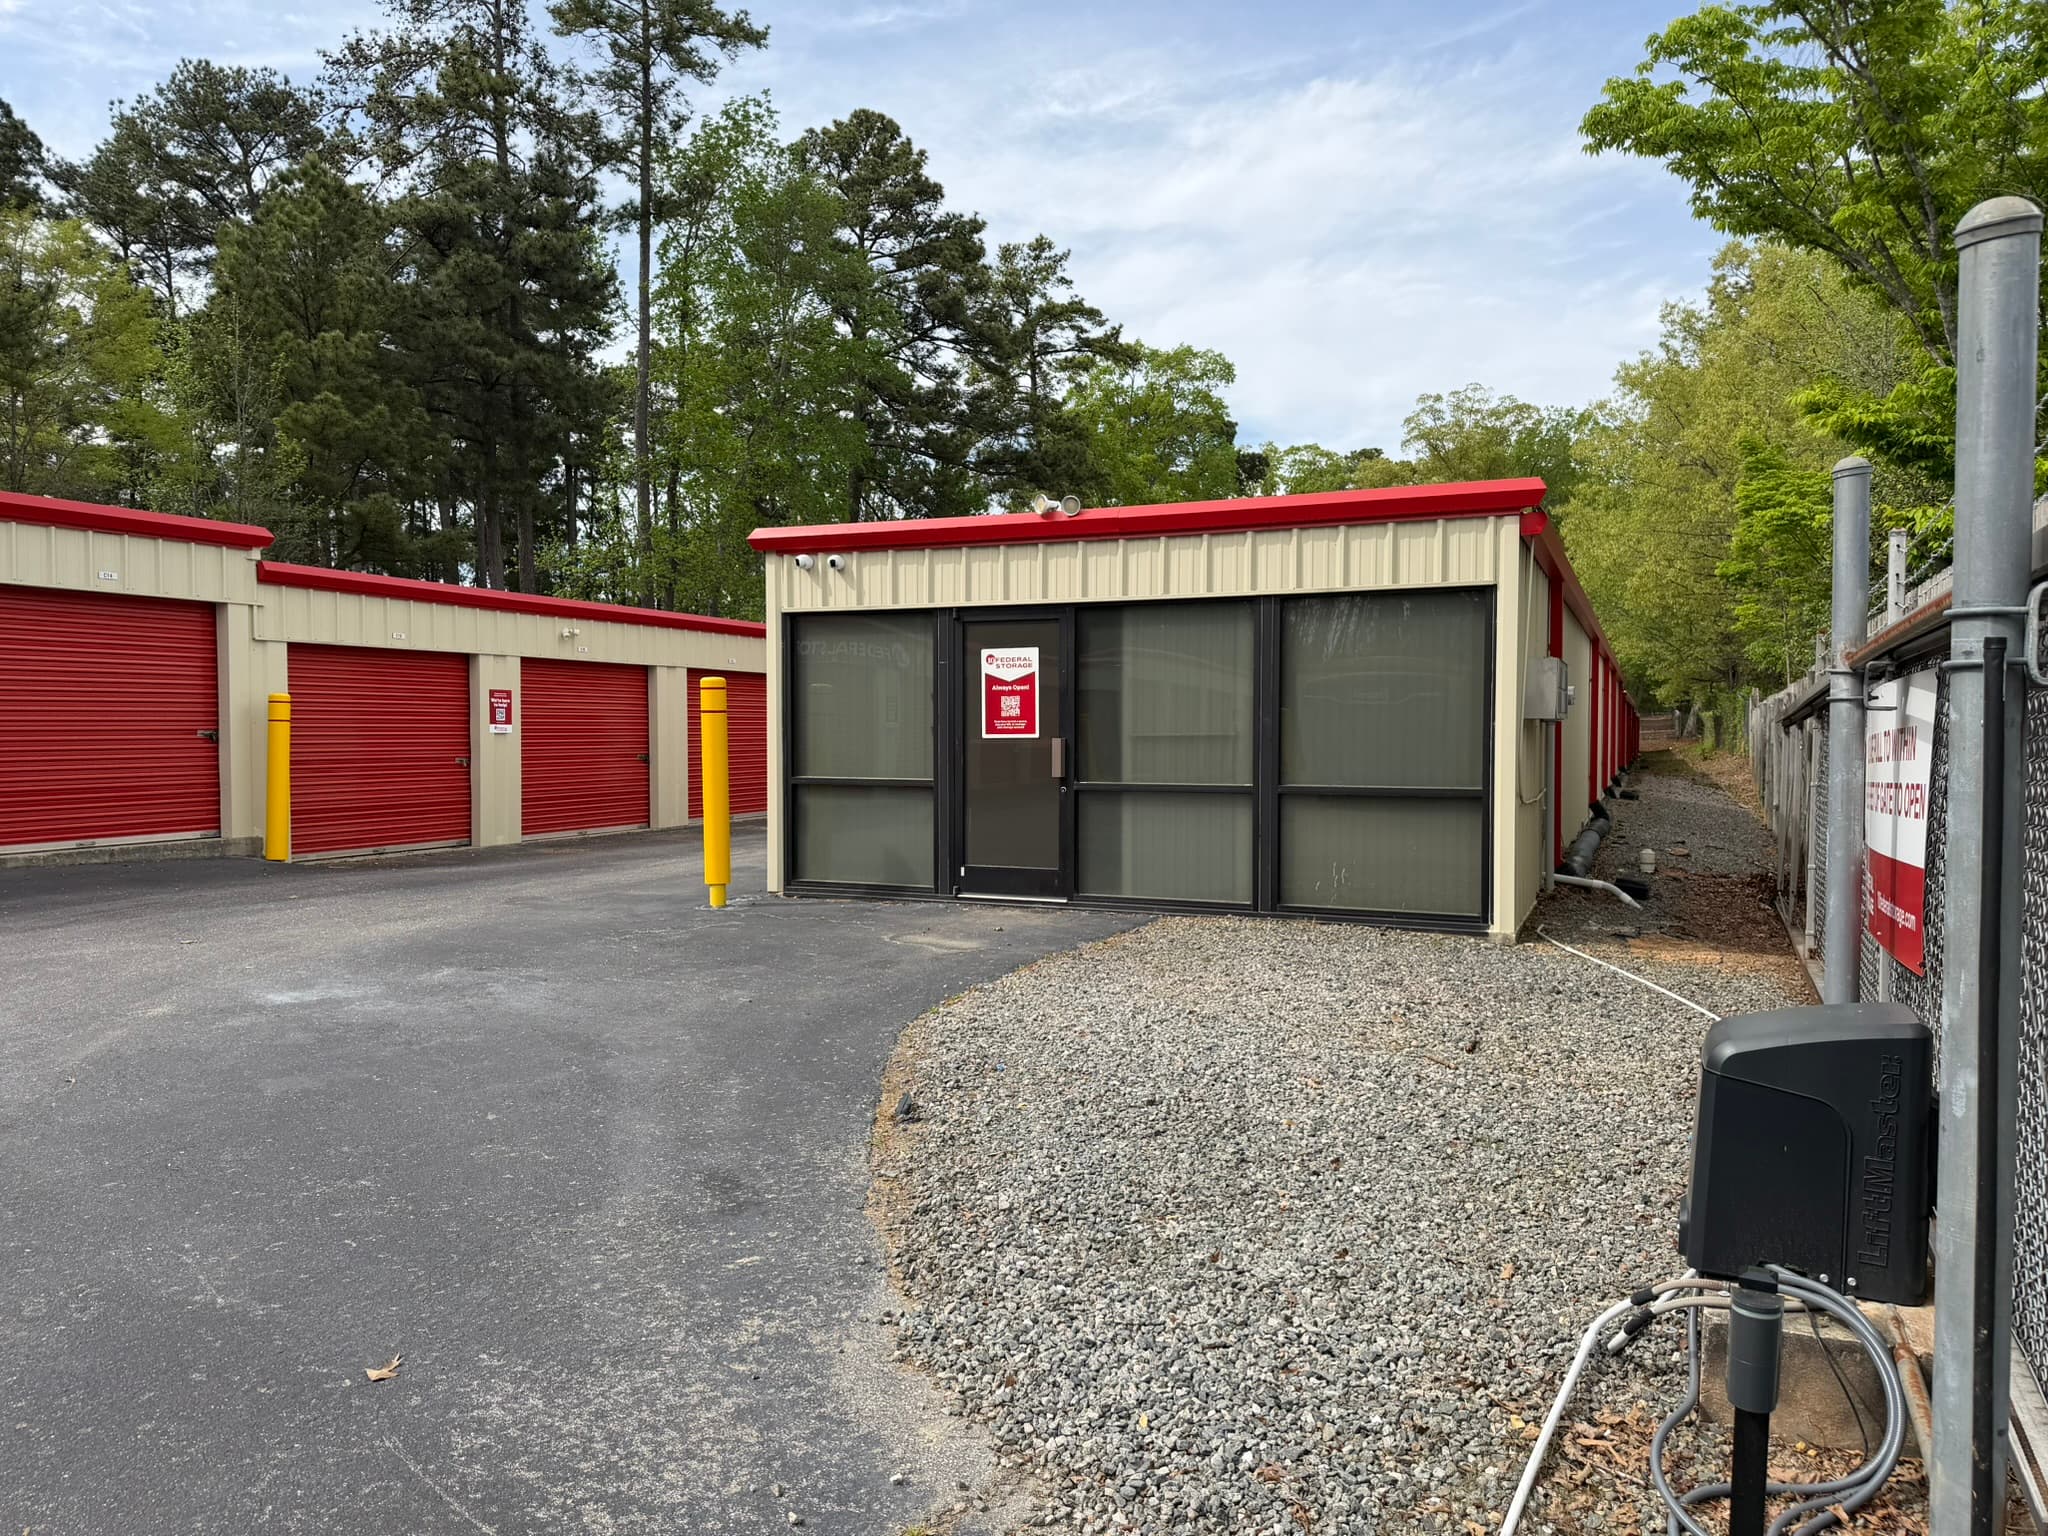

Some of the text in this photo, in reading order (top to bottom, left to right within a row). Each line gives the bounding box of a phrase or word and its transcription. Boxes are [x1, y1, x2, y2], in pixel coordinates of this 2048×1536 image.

[992, 684, 1012, 692] Always
[1884, 730, 1891, 763] TO
[1891, 725, 1918, 762] WITHIN
[1880, 783, 1893, 815] GATE
[1894, 783, 1903, 817] TO
[1904, 784, 1926, 820] OPEN
[1857, 1055, 1903, 1268] LiftMaster
